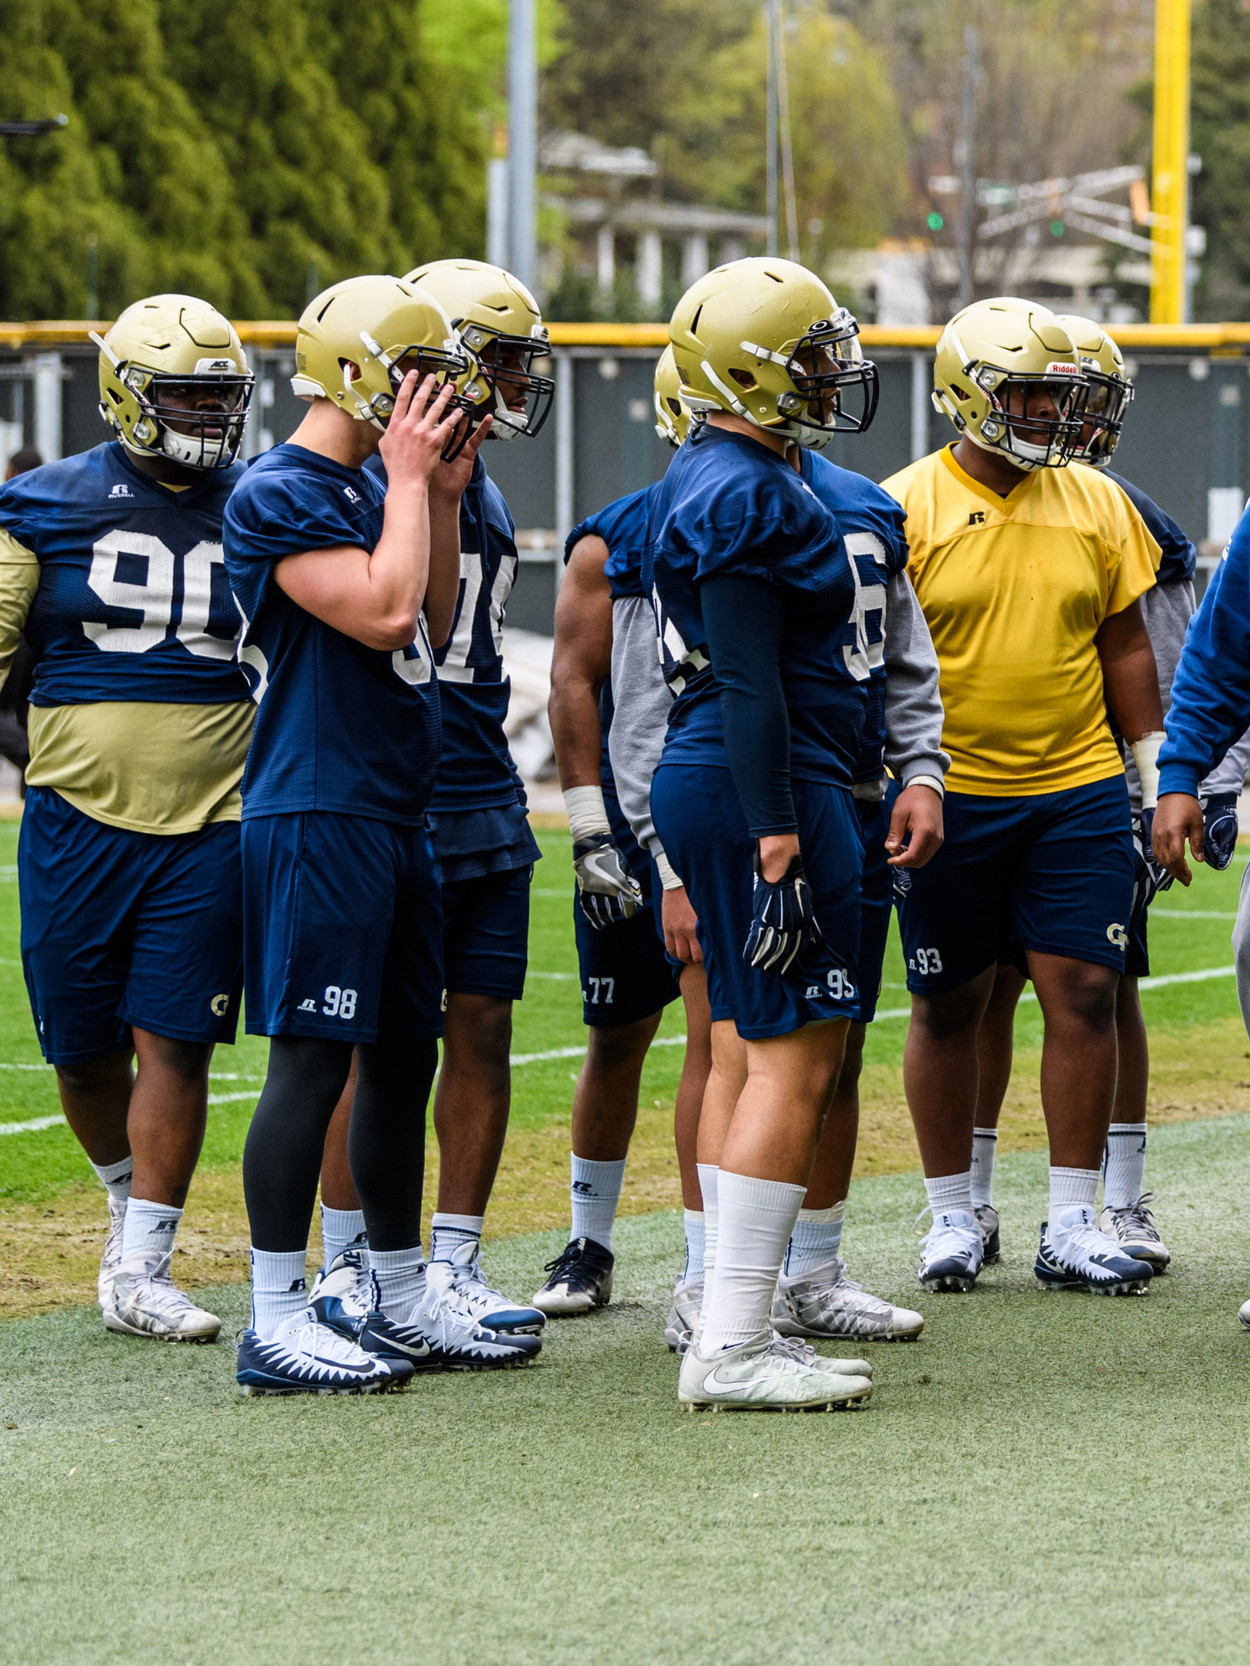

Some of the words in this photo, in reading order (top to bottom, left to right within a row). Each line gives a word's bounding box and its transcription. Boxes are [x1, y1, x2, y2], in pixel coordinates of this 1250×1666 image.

[1052, 364, 1077, 374] Riddell
[916, 948, 943, 975] 93
[323, 985, 358, 1020] 98
[588, 977, 615, 1004] 77
